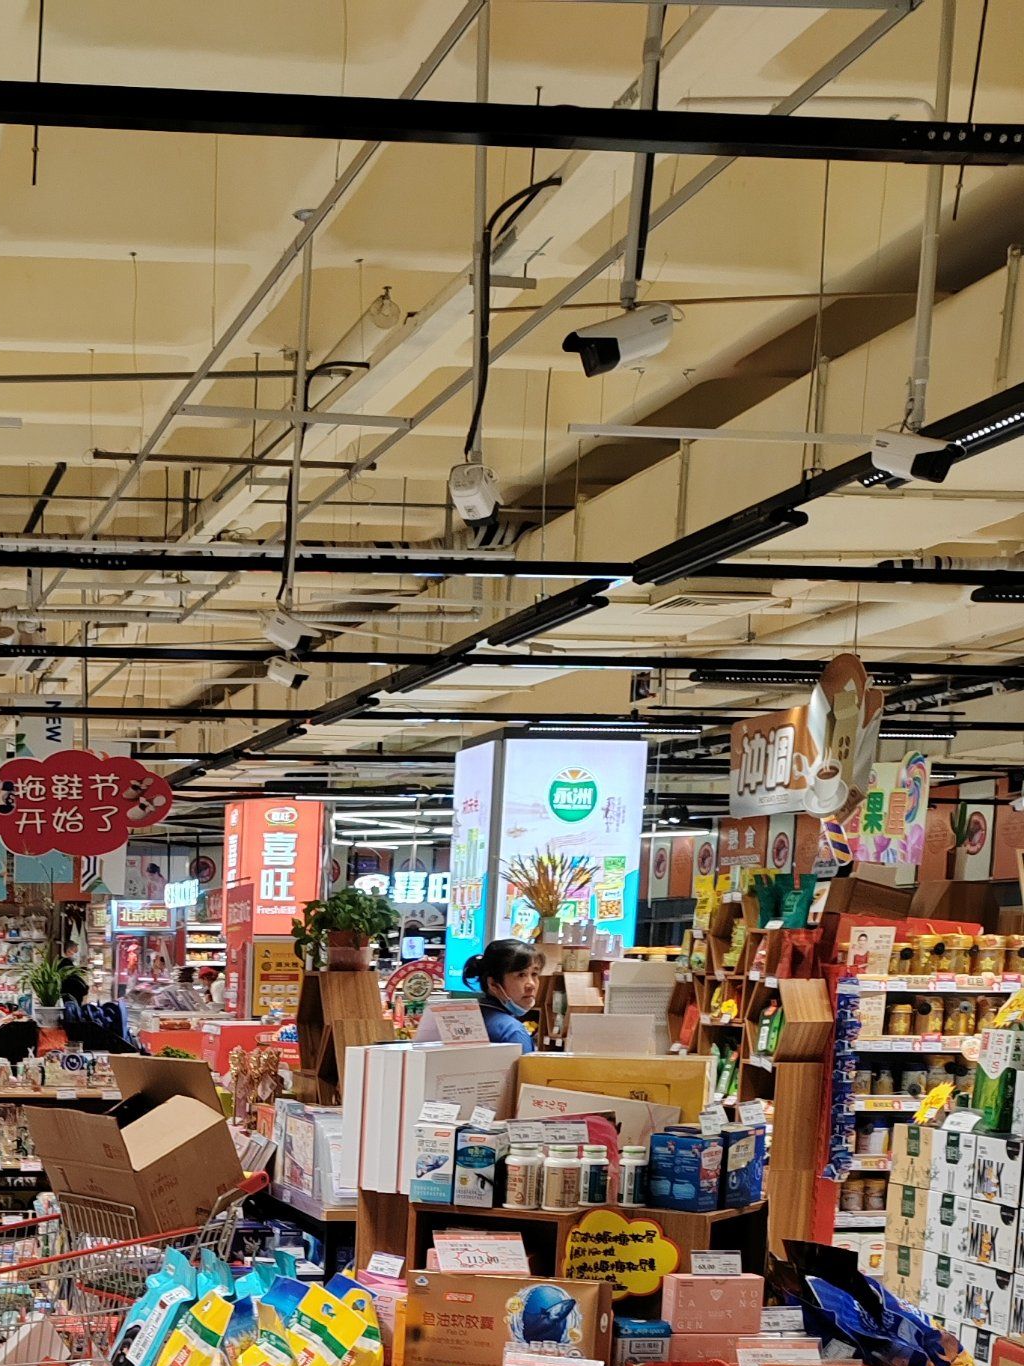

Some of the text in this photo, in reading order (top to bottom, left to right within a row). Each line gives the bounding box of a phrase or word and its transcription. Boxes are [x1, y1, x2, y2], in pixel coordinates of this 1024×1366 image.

[737, 726, 796, 795] 冲调
[14, 774, 120, 802] 拖鞋节
[14, 806, 119, 835] 开始了
[260, 832, 298, 901] 喜旺
[423, 1311, 496, 1332] 鱼油软胶囊
